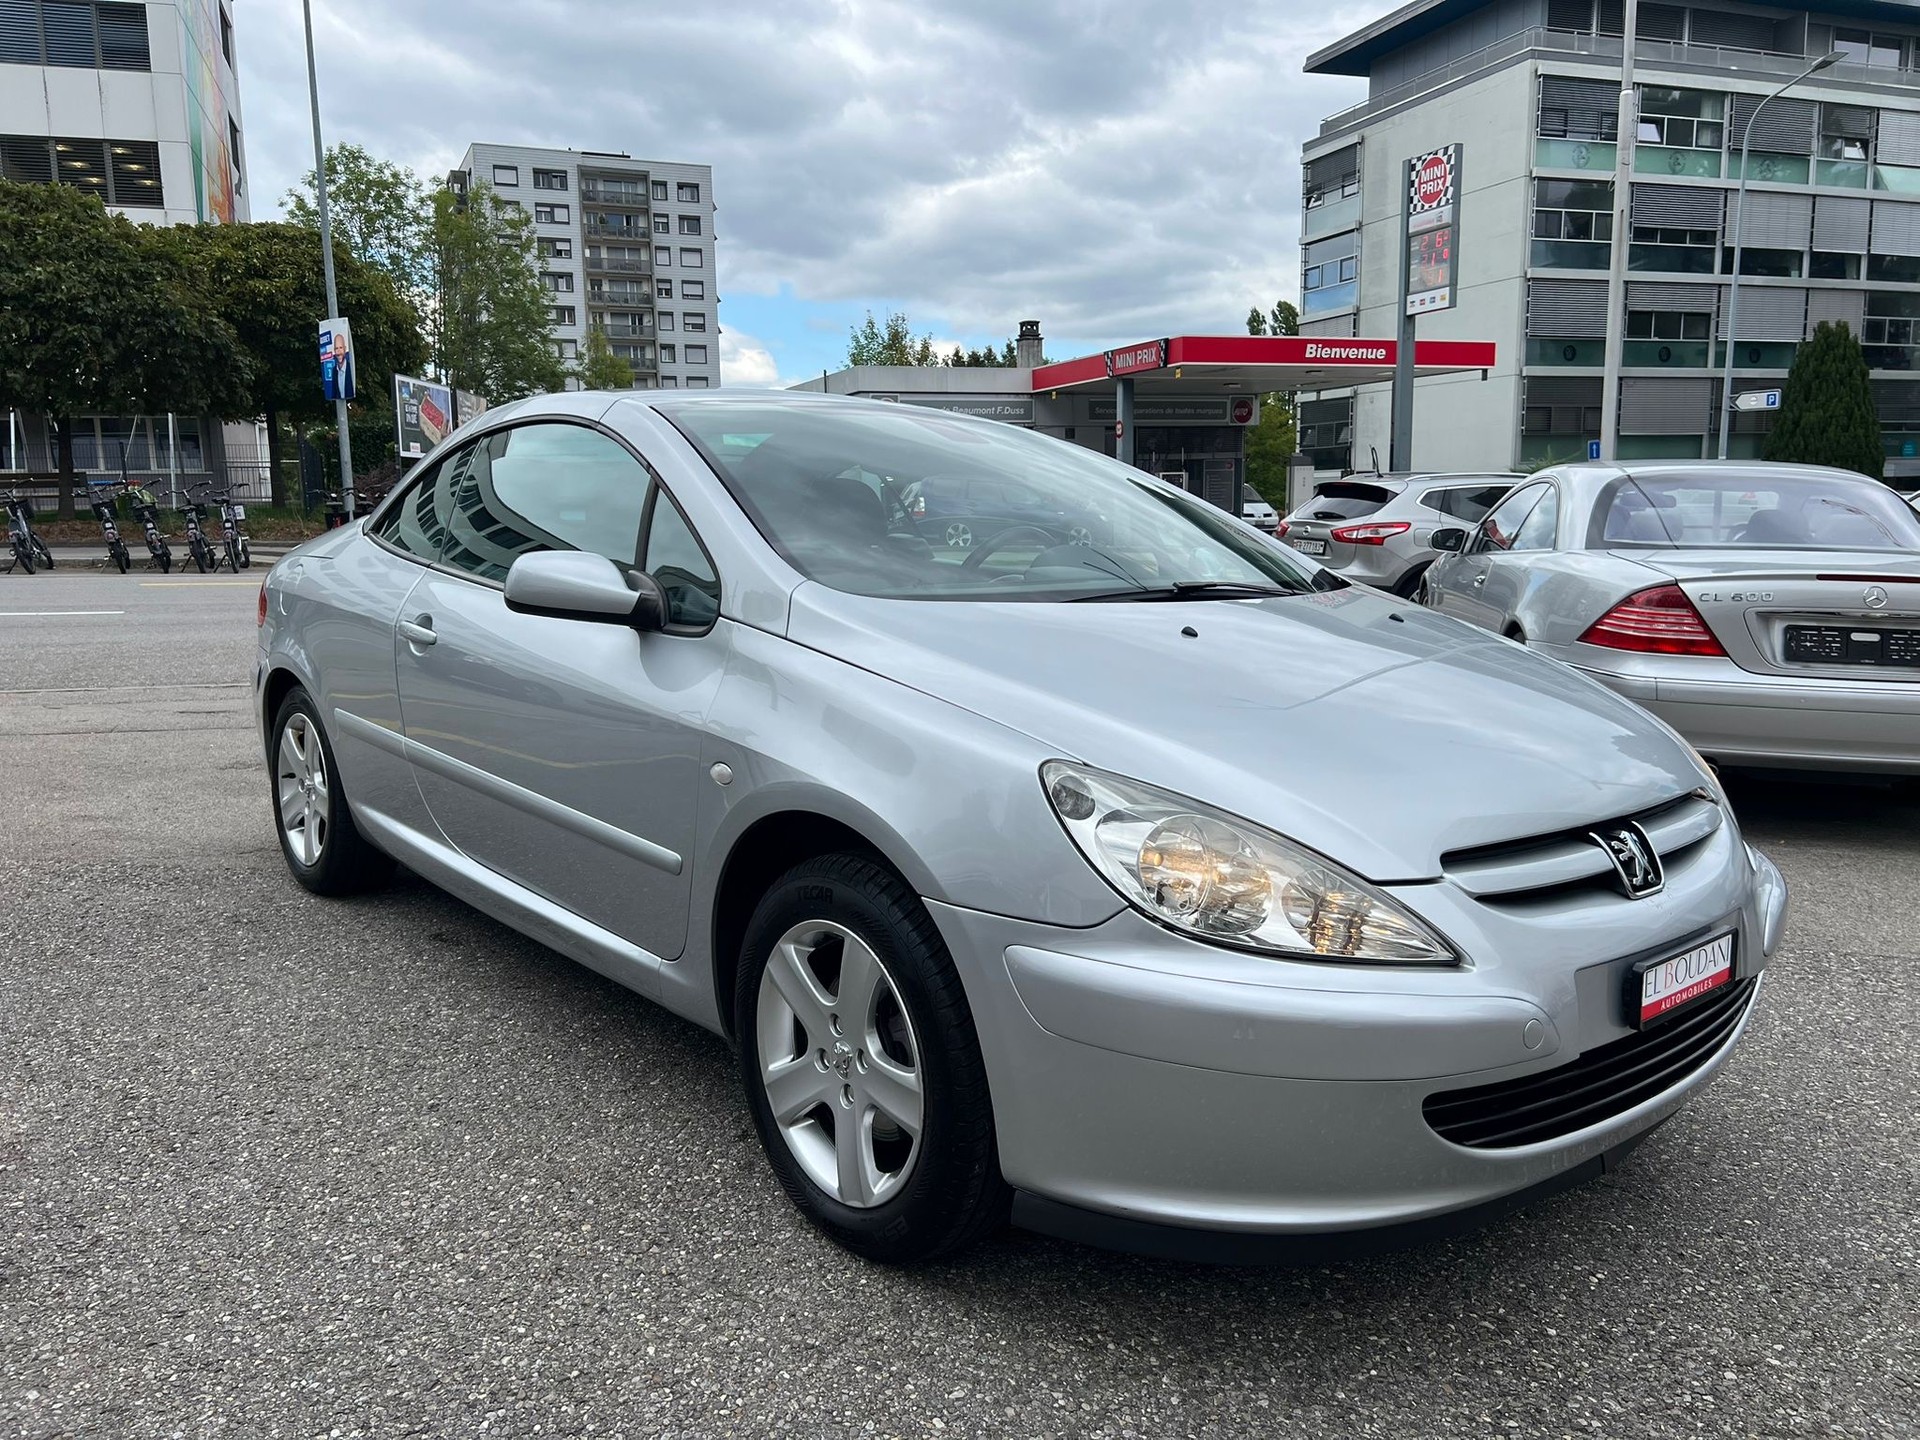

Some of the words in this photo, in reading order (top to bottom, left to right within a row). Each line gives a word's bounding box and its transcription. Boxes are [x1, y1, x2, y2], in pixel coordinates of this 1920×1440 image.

[1420, 163, 1445, 183] MINI
[1420, 177, 1445, 197] PRIX
[1115, 353, 1135, 370] MINI
[1136, 347, 1158, 366] PRIX
[1305, 343, 1387, 359] Bienvenue
[952, 406, 995, 415] Beaumont
[996, 406, 1025, 415] F.Duss
[1699, 592, 1723, 602] CL
[1731, 591, 1774, 602] 600
[1644, 967, 1661, 998] EL
[1660, 978, 1713, 1011] AUTOMOBILES
